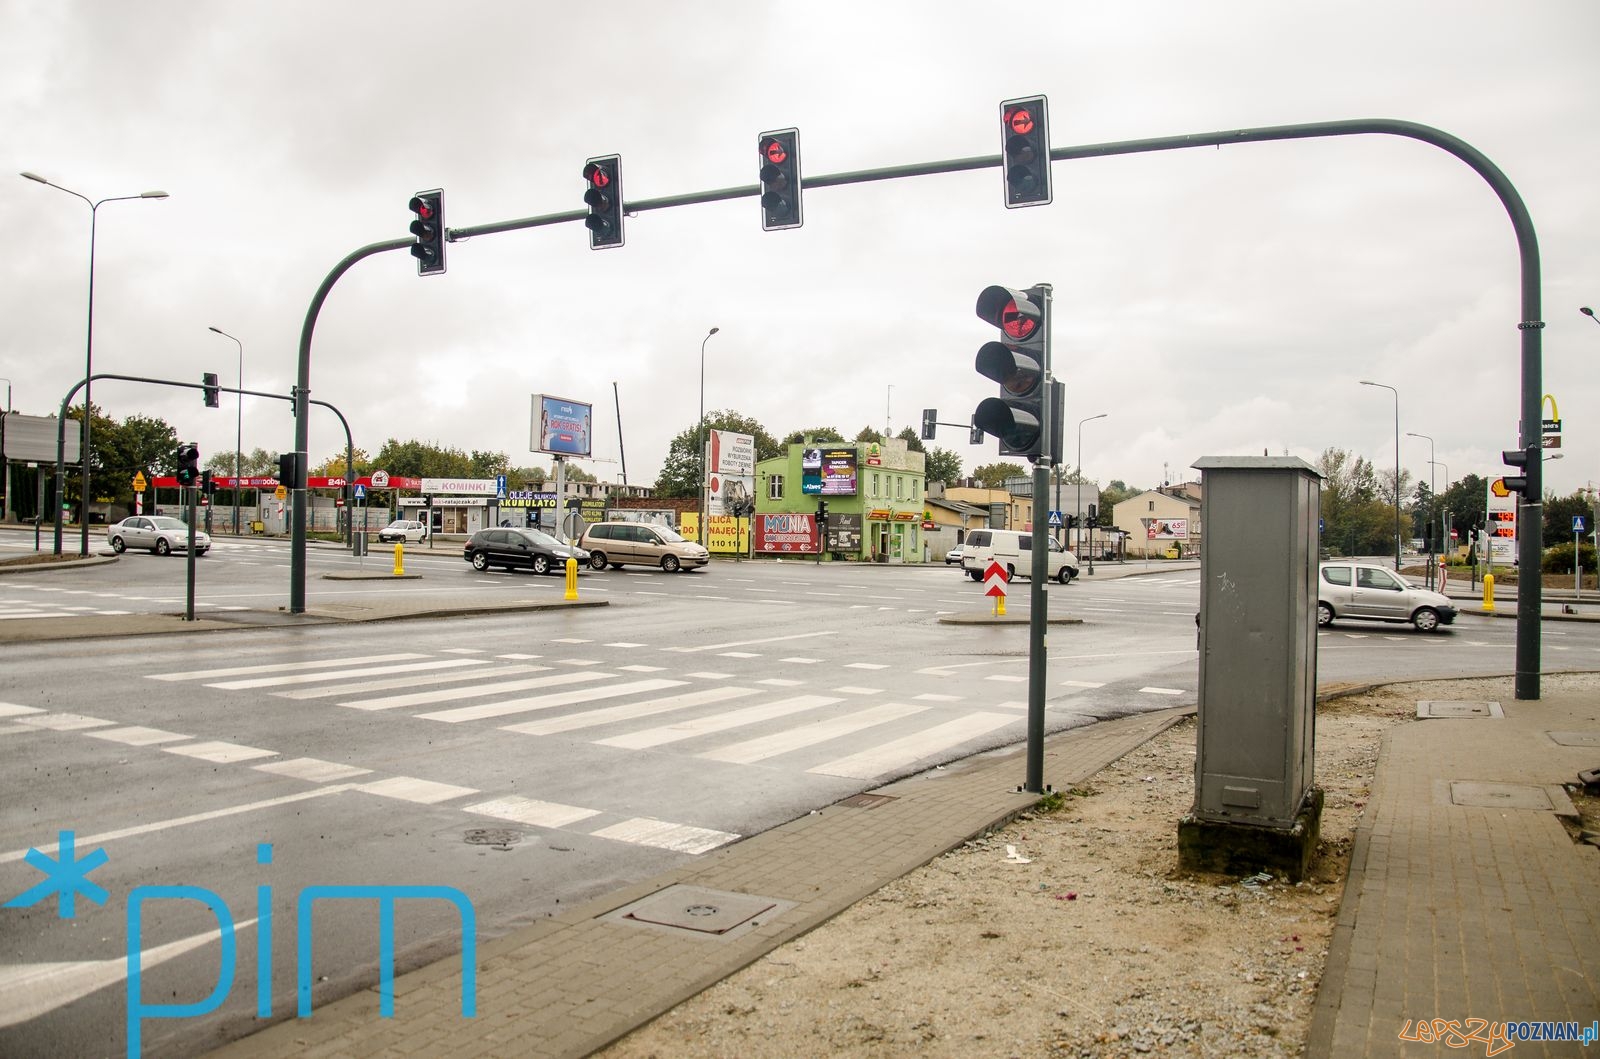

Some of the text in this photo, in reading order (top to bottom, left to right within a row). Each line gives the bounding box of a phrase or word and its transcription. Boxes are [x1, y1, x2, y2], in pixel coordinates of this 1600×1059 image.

[328, 478, 346, 486] 24h
[441, 482, 487, 491] KOMINKI
[509, 491, 533, 499] OLEJE
[498, 499, 569, 507] AKUMULATOY
[763, 515, 811, 534] MYJNIA
[683, 526, 694, 534] DO
